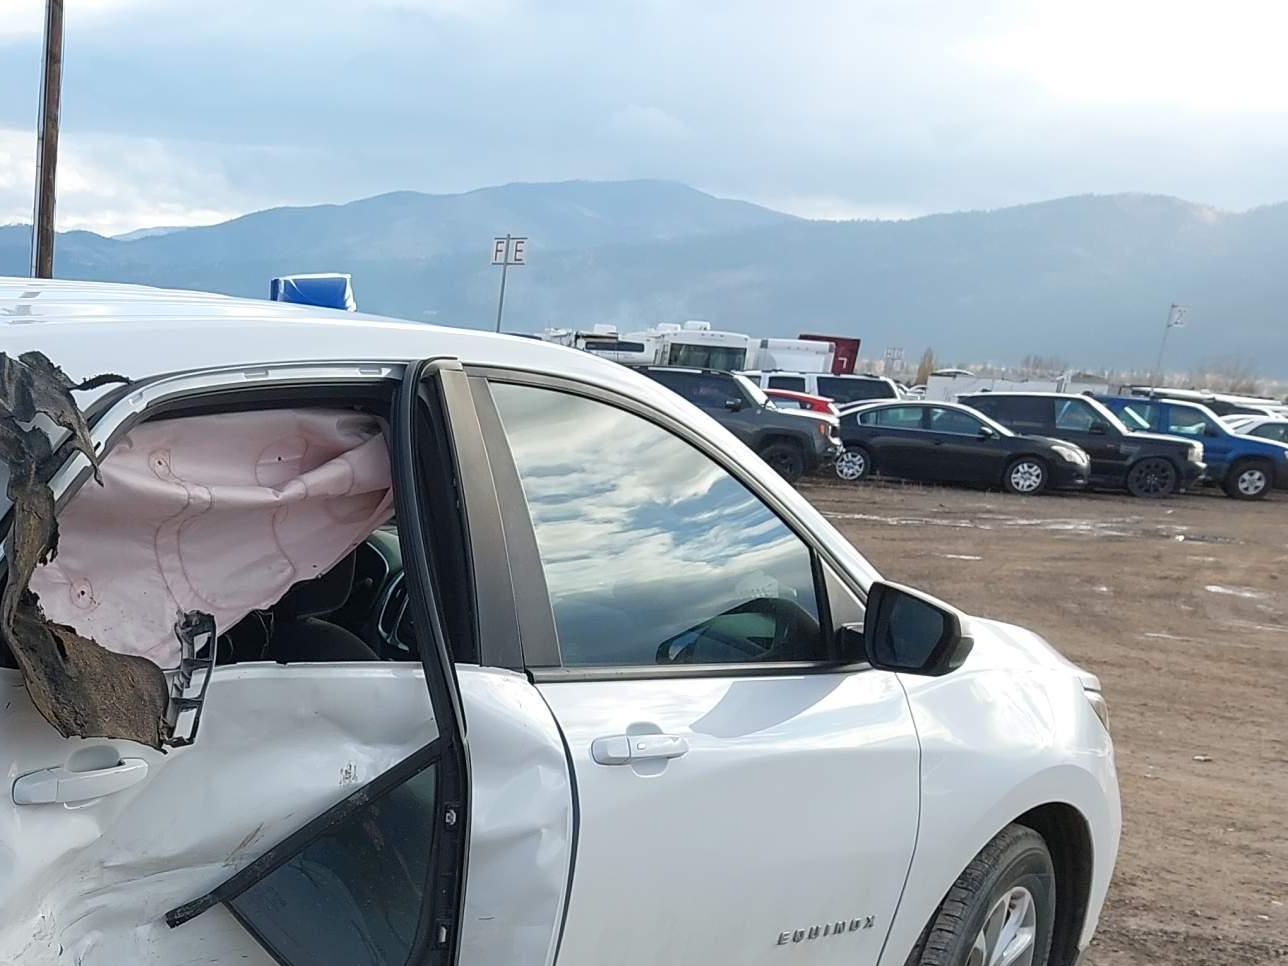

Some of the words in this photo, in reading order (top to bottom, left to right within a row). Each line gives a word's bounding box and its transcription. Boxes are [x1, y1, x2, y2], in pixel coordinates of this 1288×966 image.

[494, 241, 505, 261] F
[514, 241, 524, 261] E
[776, 915, 876, 946] EQUINOX
